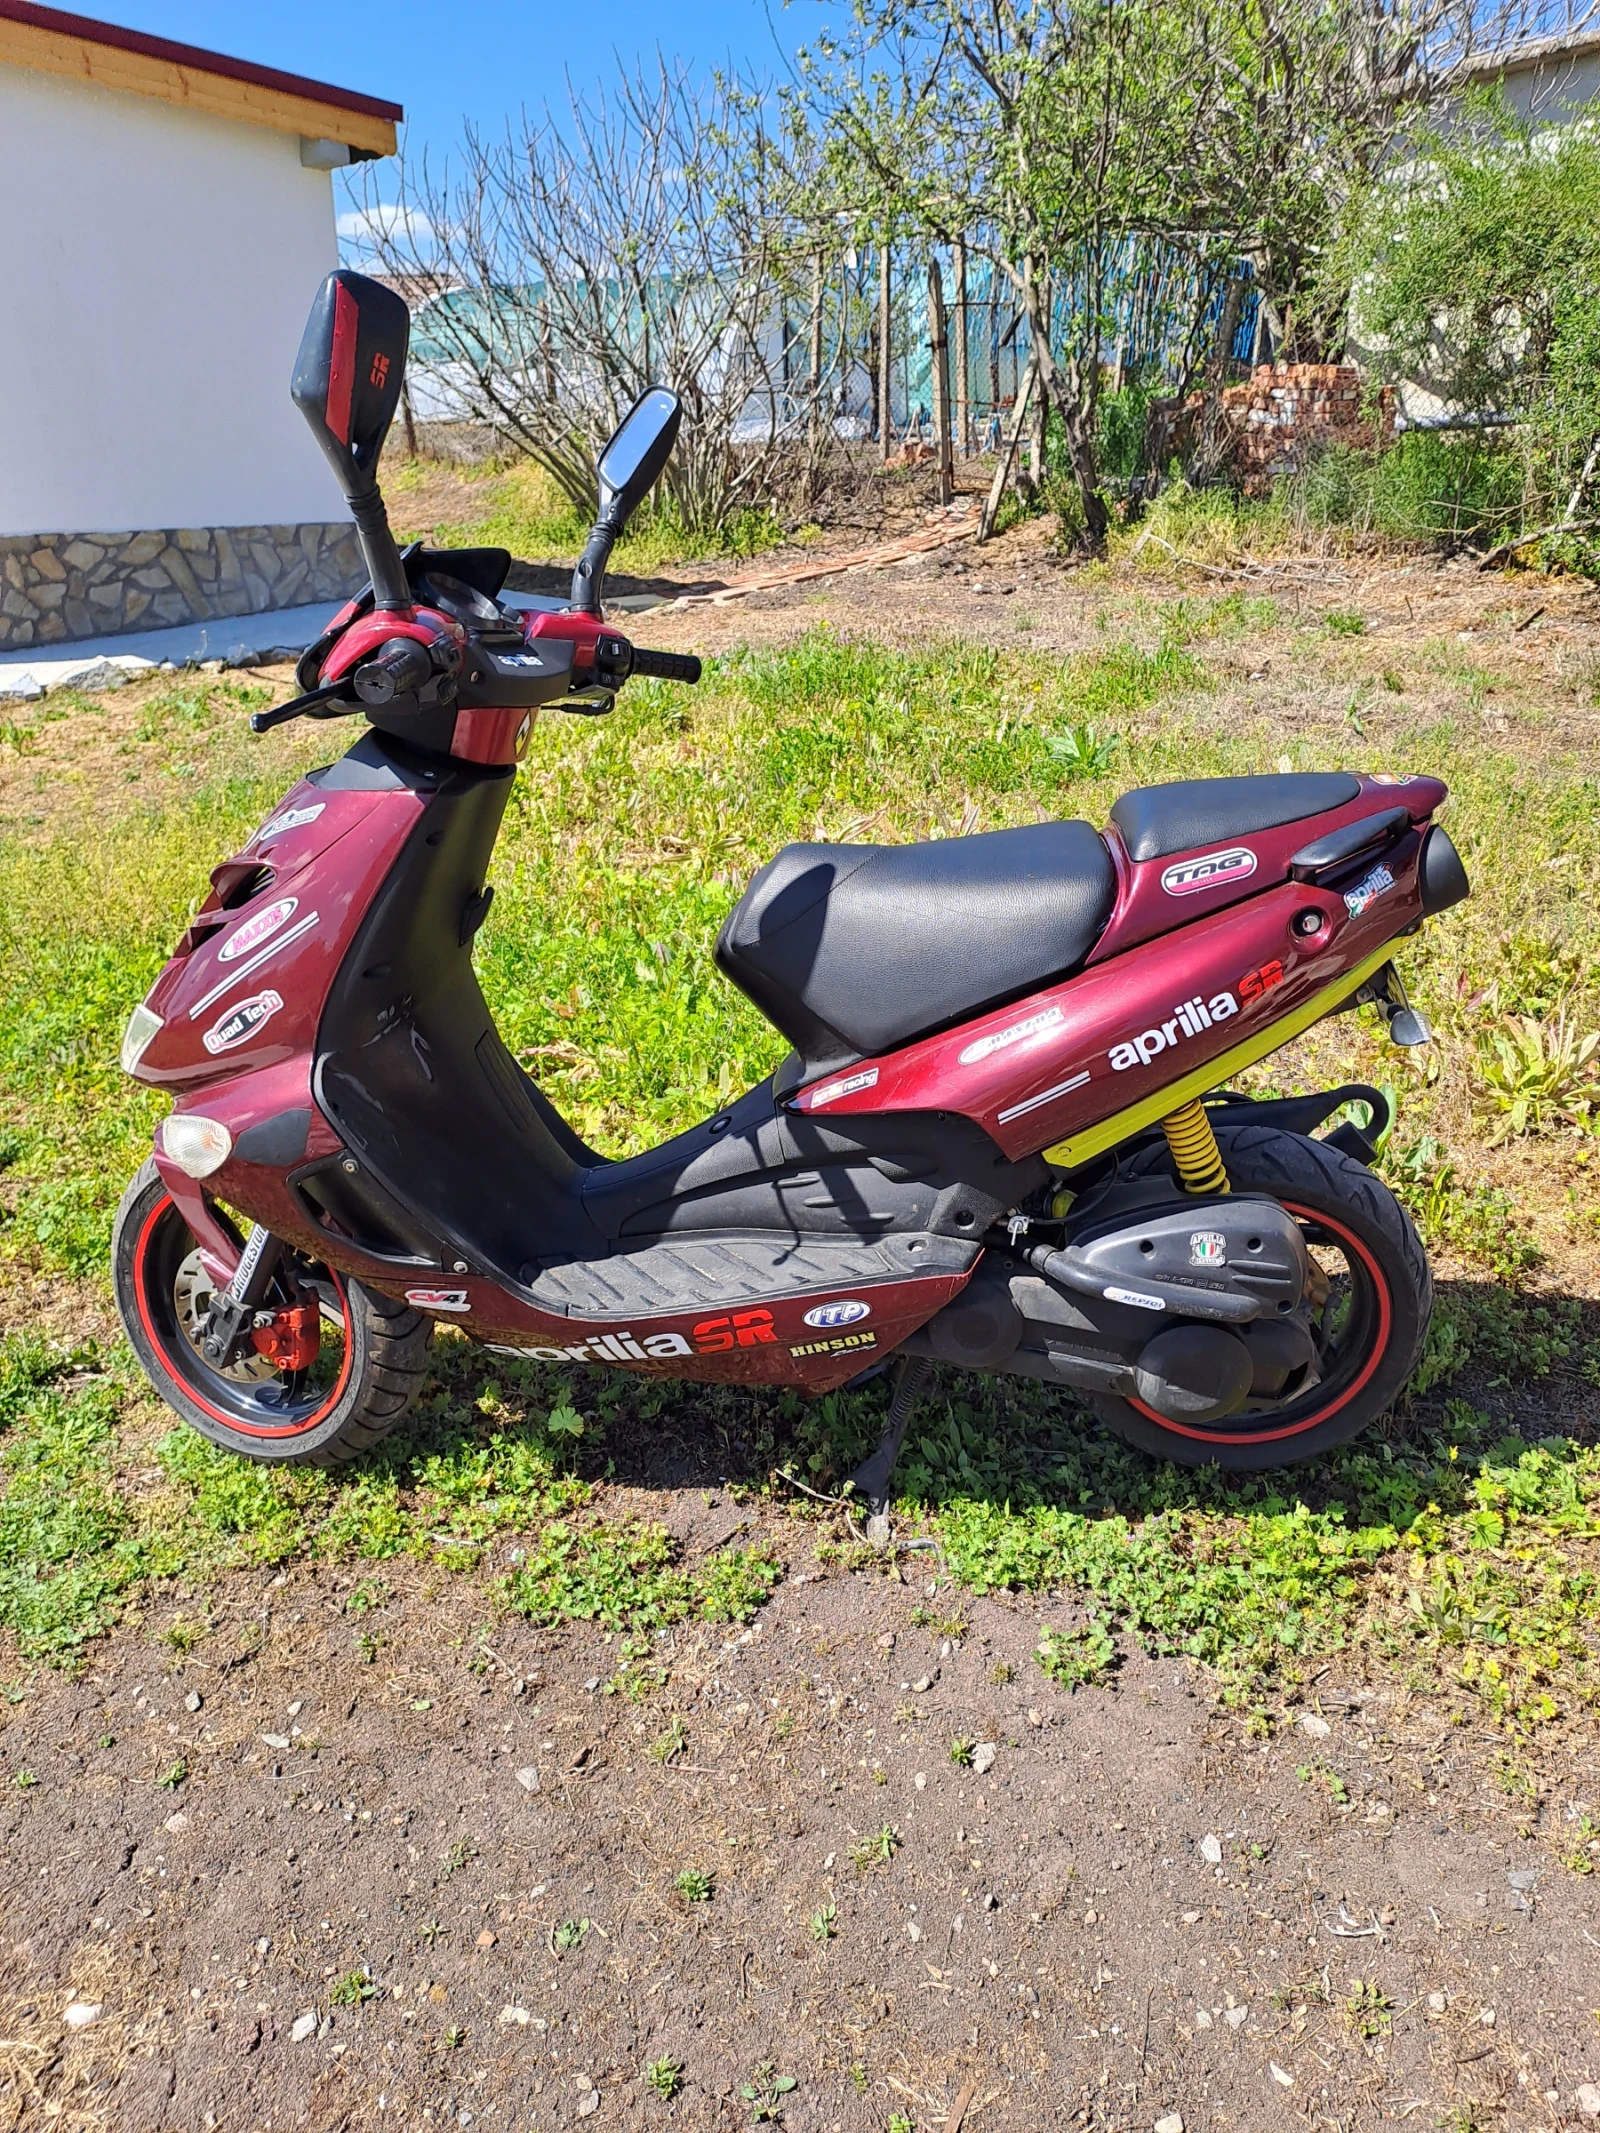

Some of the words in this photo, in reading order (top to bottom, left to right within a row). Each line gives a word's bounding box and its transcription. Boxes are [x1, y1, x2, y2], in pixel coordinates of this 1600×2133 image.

[370, 352, 390, 389] SR
[1166, 853, 1248, 884] TAG
[1346, 864, 1394, 908] aprilia
[233, 905, 283, 954] MAXXIS
[207, 1016, 244, 1049] Quad
[242, 994, 279, 1023] Tech
[1107, 991, 1239, 1071] aprilia
[1238, 960, 1285, 1007] SR
[1192, 1234, 1224, 1245] APRILIA
[812, 1303, 862, 1325] ITP
[483, 1331, 694, 1362] aprilia
[692, 1309, 779, 1355] SR
[788, 1331, 877, 1358] HINSON
